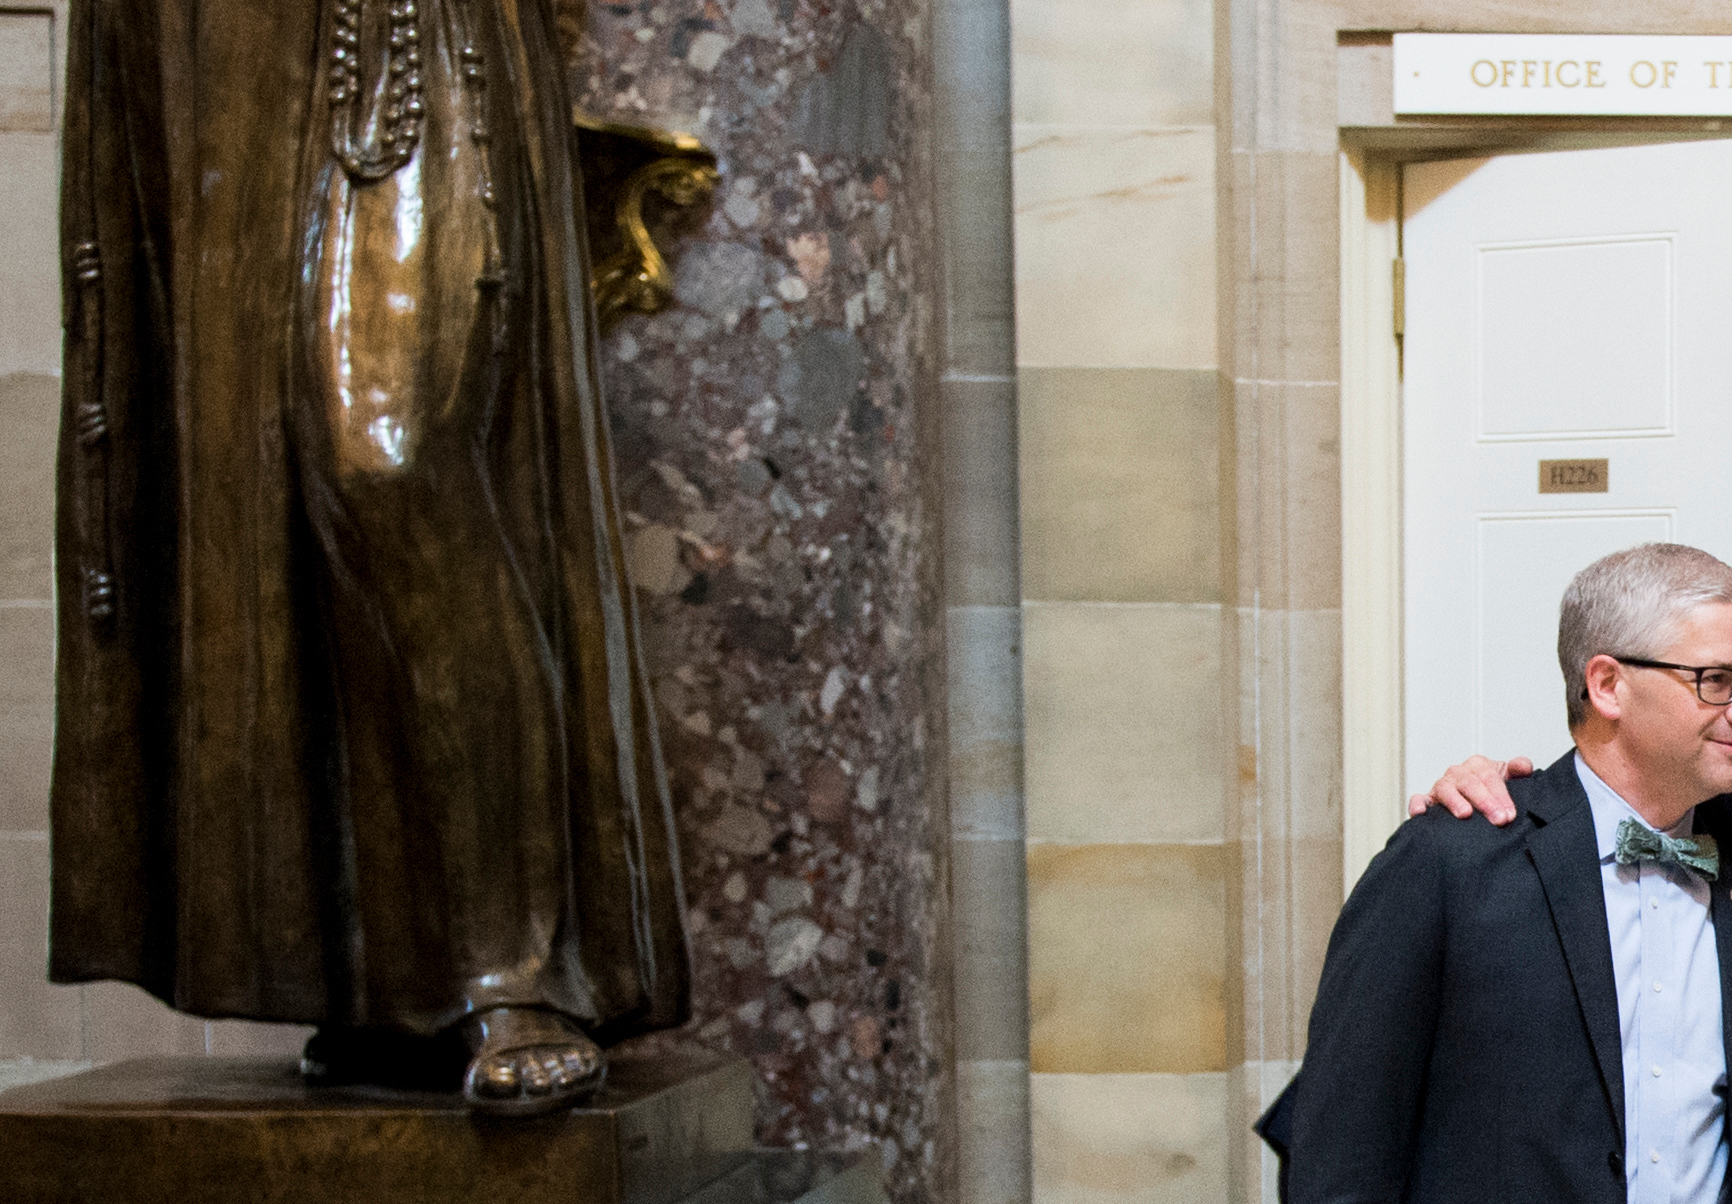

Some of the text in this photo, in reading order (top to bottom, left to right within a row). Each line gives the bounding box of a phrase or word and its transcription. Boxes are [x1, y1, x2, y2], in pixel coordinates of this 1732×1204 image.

[1470, 60, 1607, 89] OFFICE
[1629, 60, 1678, 89] OF
[1550, 465, 1600, 486] H226
